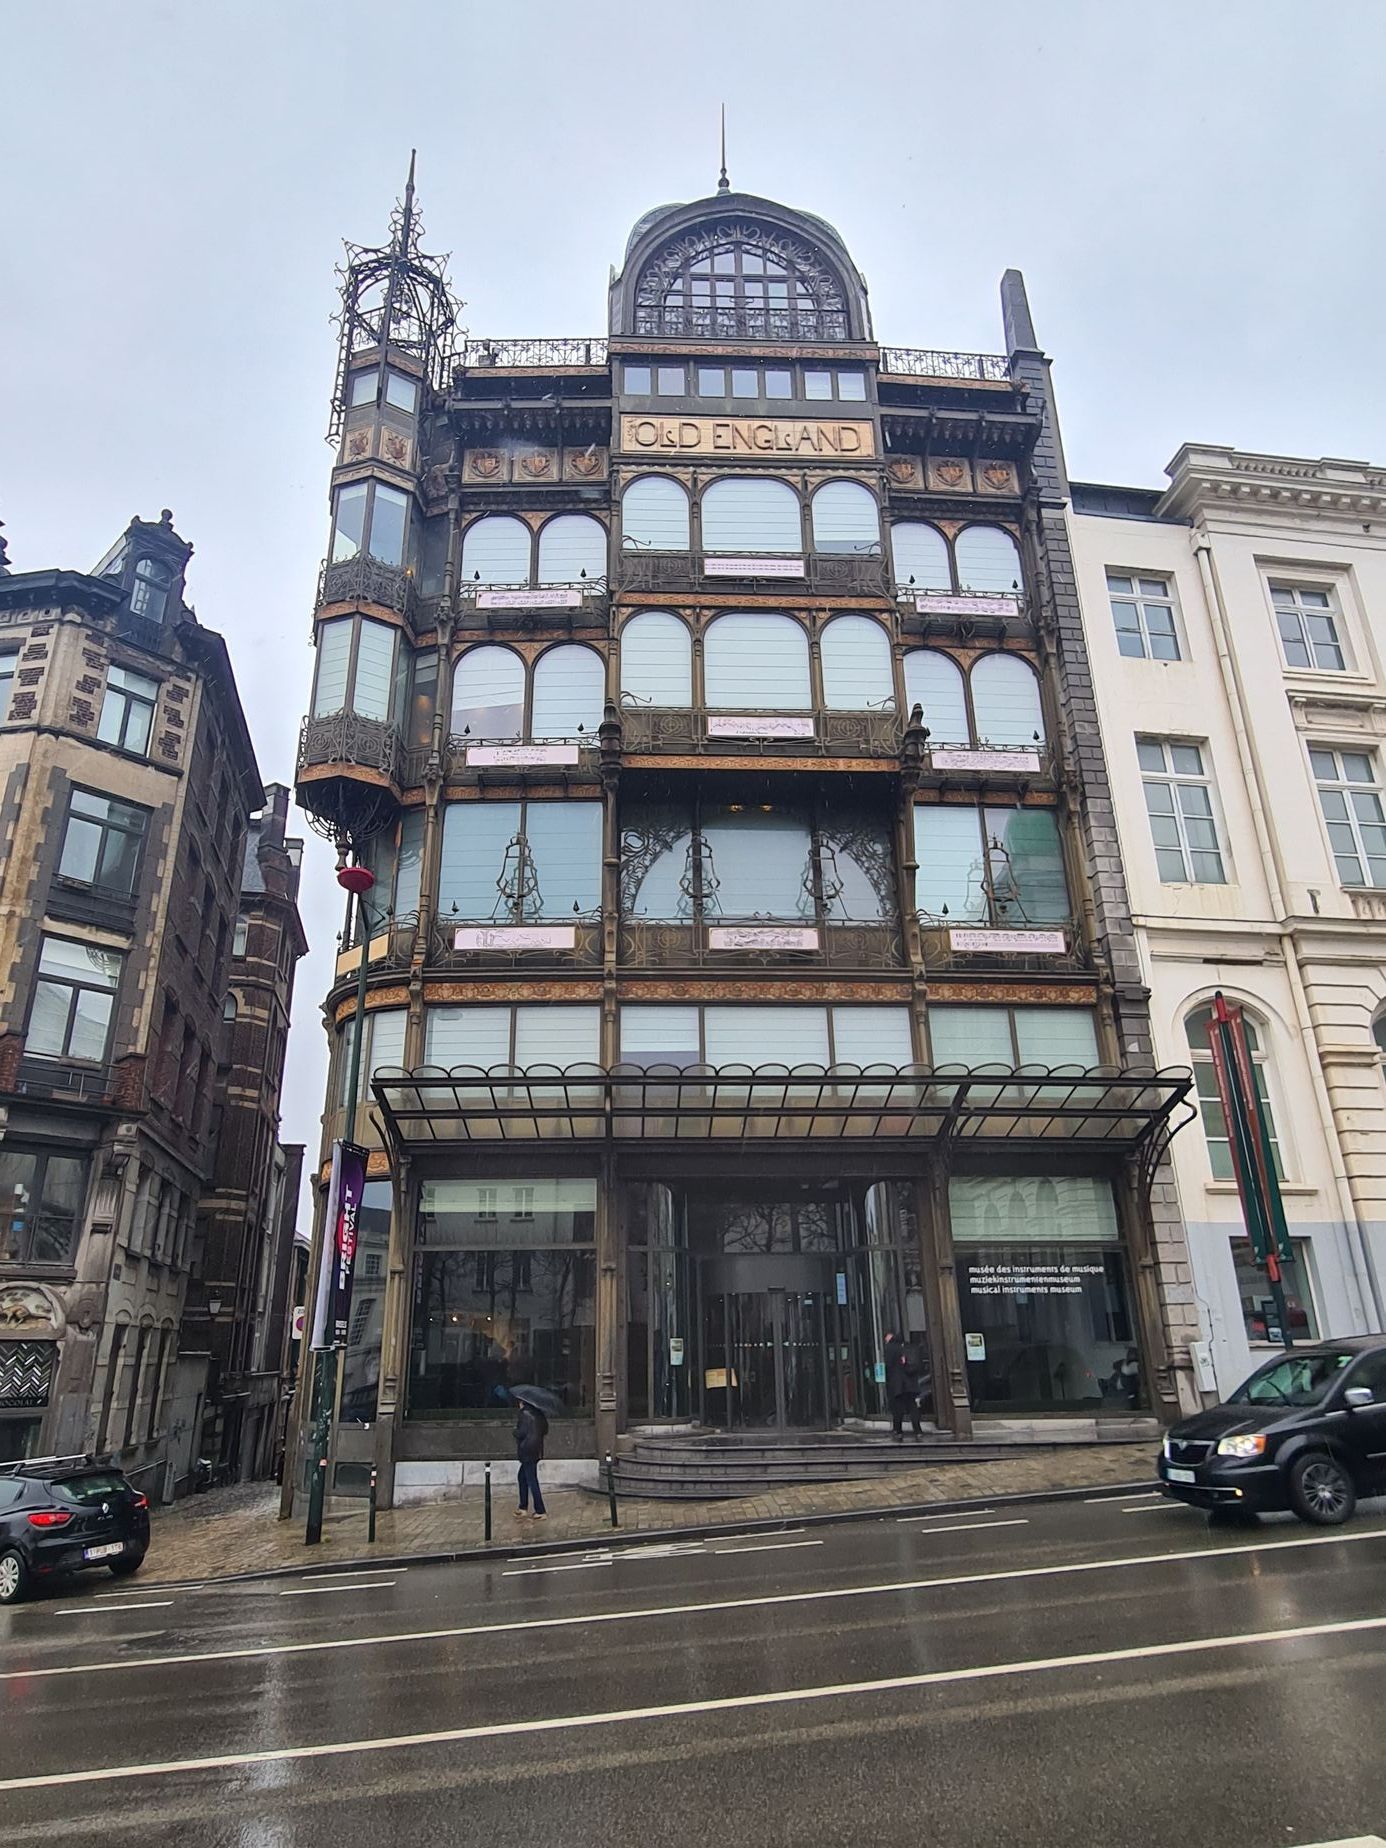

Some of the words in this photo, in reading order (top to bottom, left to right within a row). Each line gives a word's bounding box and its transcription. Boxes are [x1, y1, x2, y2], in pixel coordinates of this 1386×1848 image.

[635, 421, 701, 449] OLD
[713, 424, 861, 452] ENGLAND
[338, 1184, 353, 1290] BRIGHT
[345, 1203, 357, 1275] FESTIVAL
[968, 1265, 995, 1273] musée
[996, 1265, 1011, 1273] des
[1012, 1265, 1058, 1273] instruments
[1060, 1265, 1071, 1273] de
[1072, 1265, 1104, 1275] musique
[970, 1275, 1081, 1283] muziekinstrumentenmuseum
[971, 1285, 1001, 1294] musical
[1002, 1285, 1048, 1294] instruments
[1050, 1286, 1082, 1294] museum
